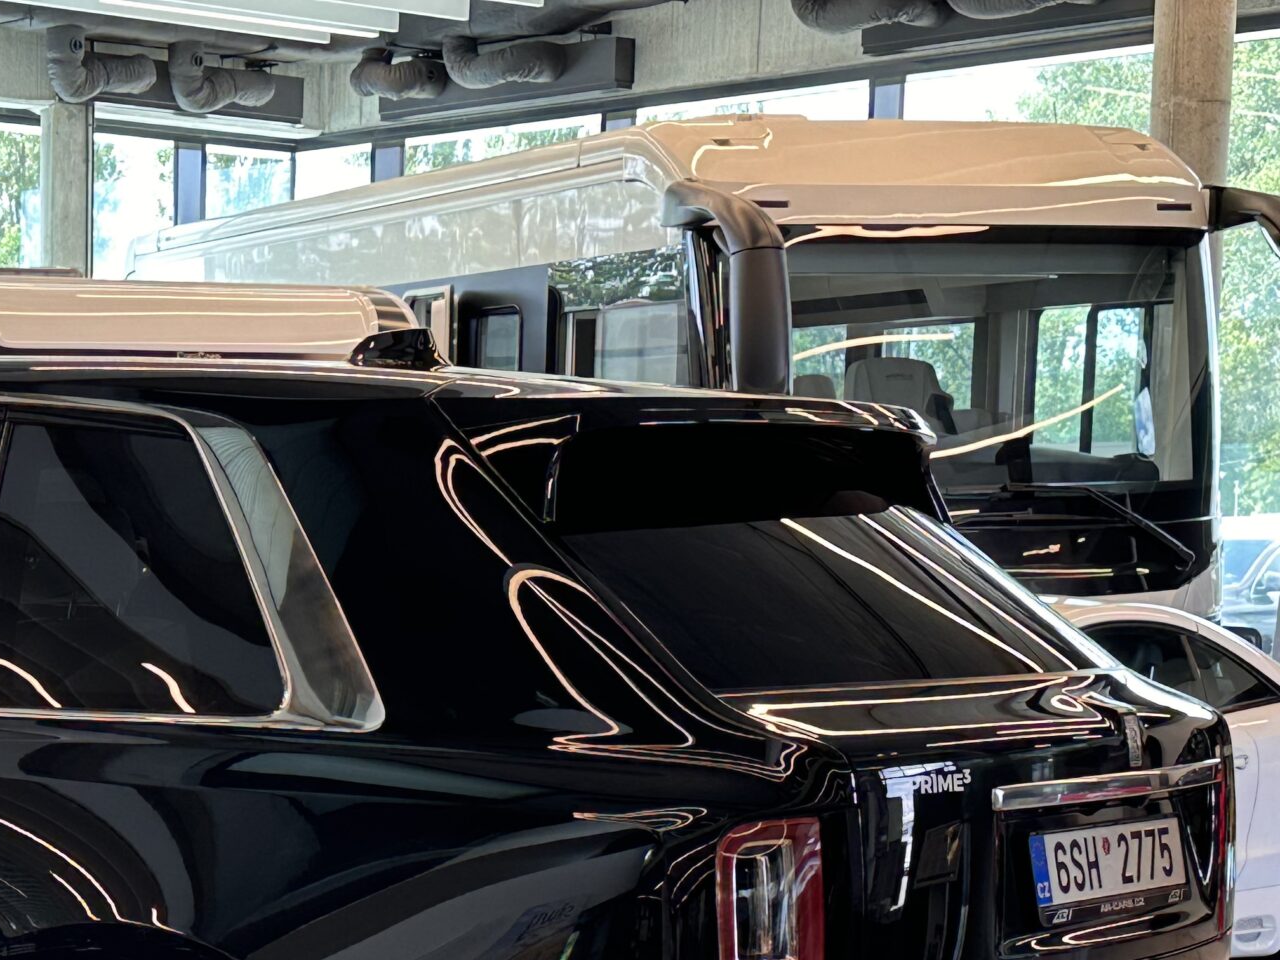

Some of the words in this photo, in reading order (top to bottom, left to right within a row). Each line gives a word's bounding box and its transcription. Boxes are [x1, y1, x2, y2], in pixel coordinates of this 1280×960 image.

[1054, 836, 1102, 894] 6SH
[1117, 827, 1174, 884] 2775
[1037, 882, 1051, 898] CZ
